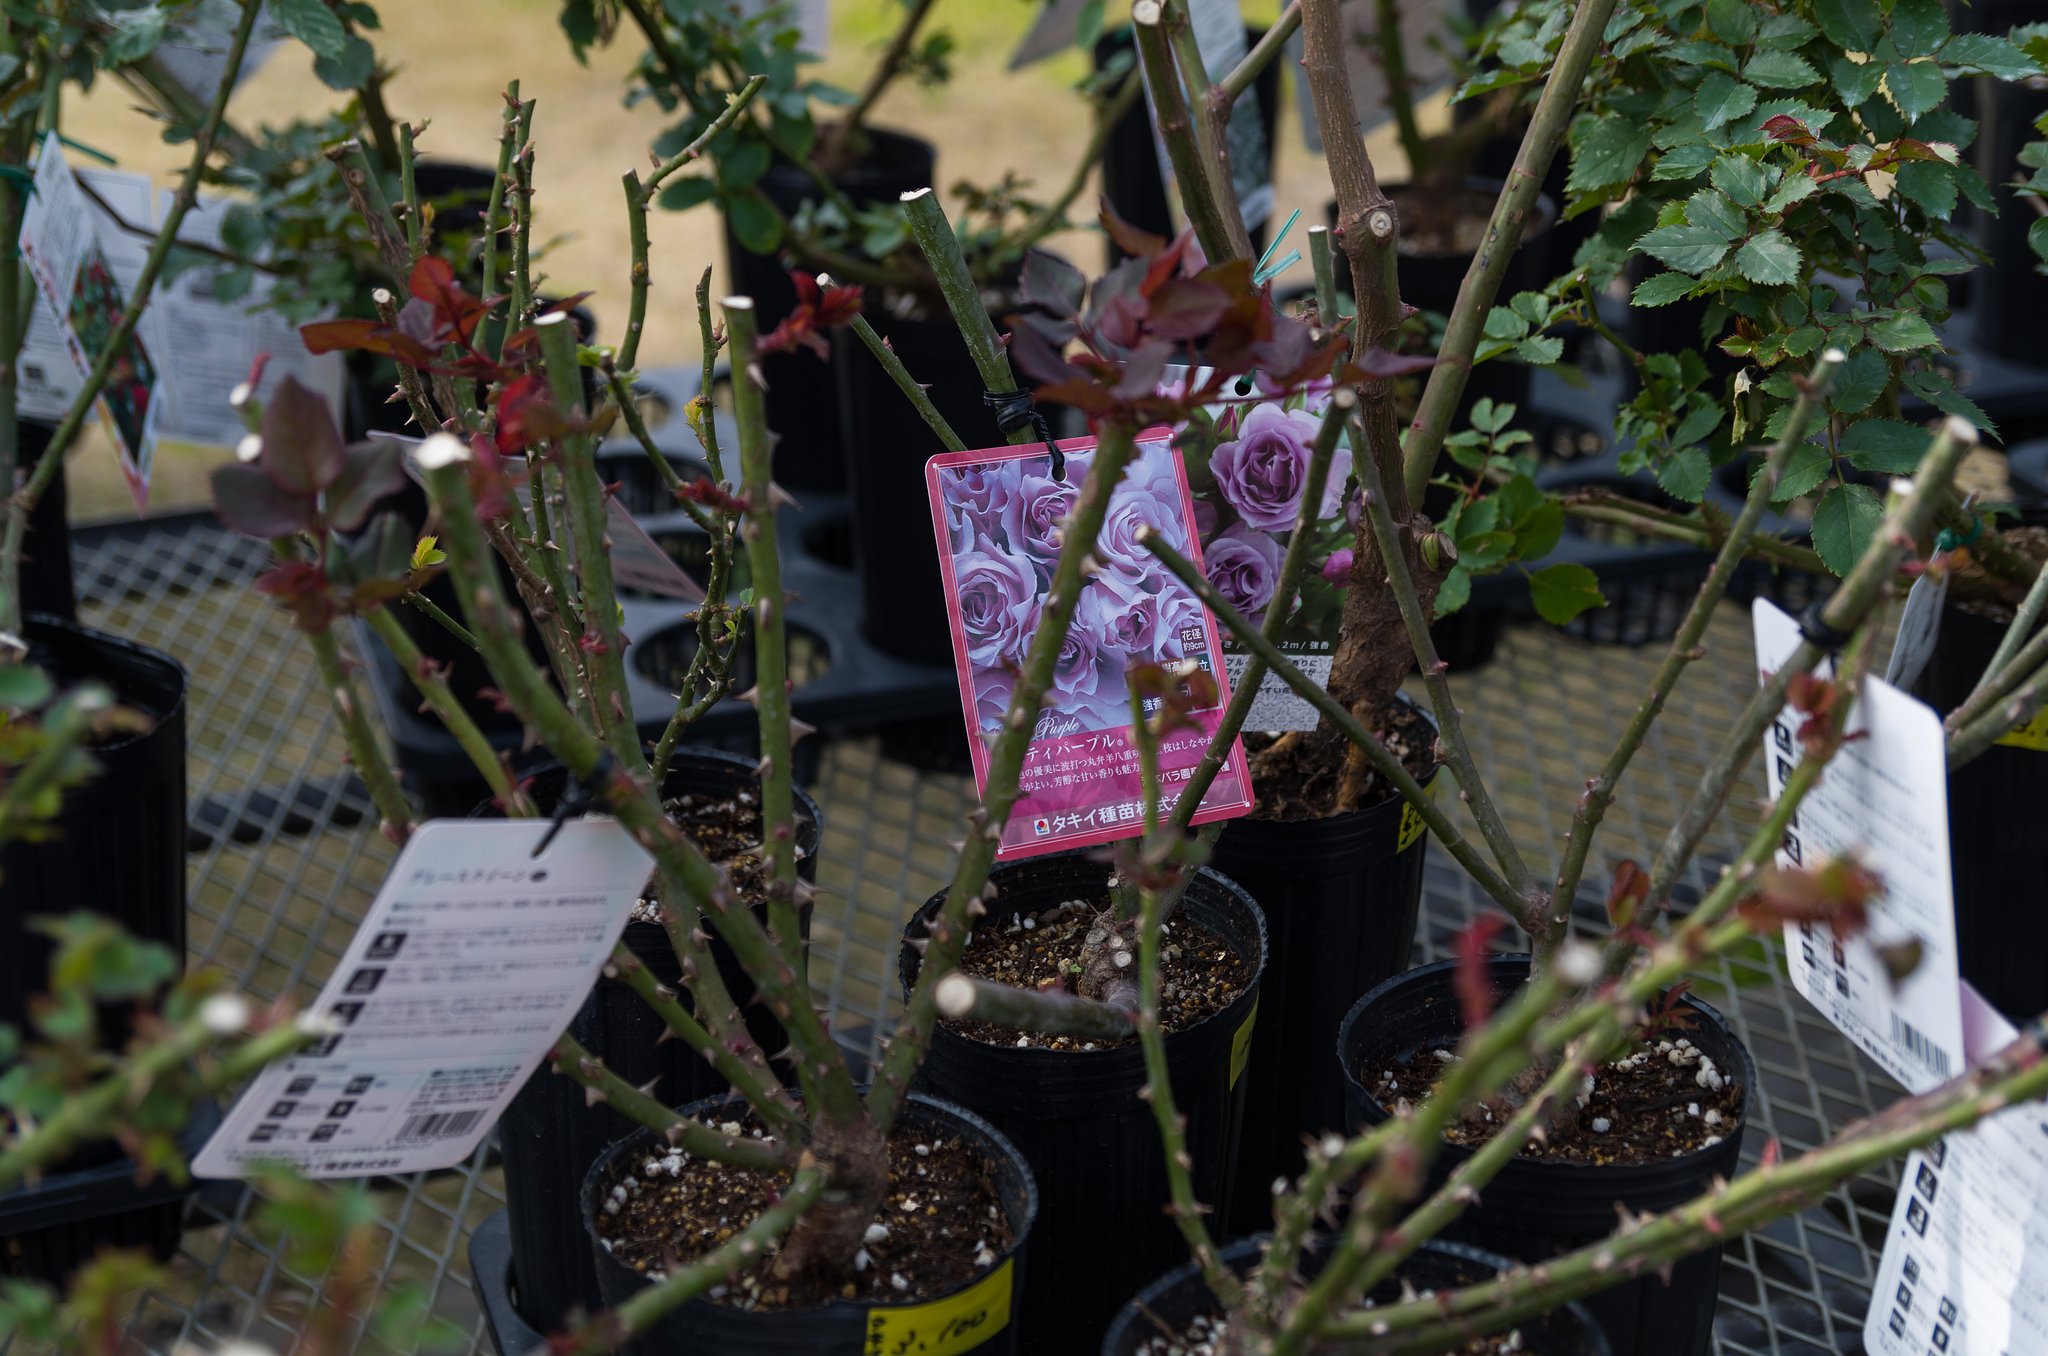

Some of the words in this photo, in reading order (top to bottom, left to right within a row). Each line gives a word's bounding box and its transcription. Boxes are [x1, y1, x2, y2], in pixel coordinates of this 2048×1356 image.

[1181, 628, 1202, 641] 花径
[1182, 641, 1205, 651] 約9cm
[1142, 697, 1163, 711] 強香
[1035, 715, 1080, 740] Purple
[1026, 734, 1124, 762] ティパープル®
[1019, 762, 1140, 792] がよい。芳醇な甘い香りも魅力
